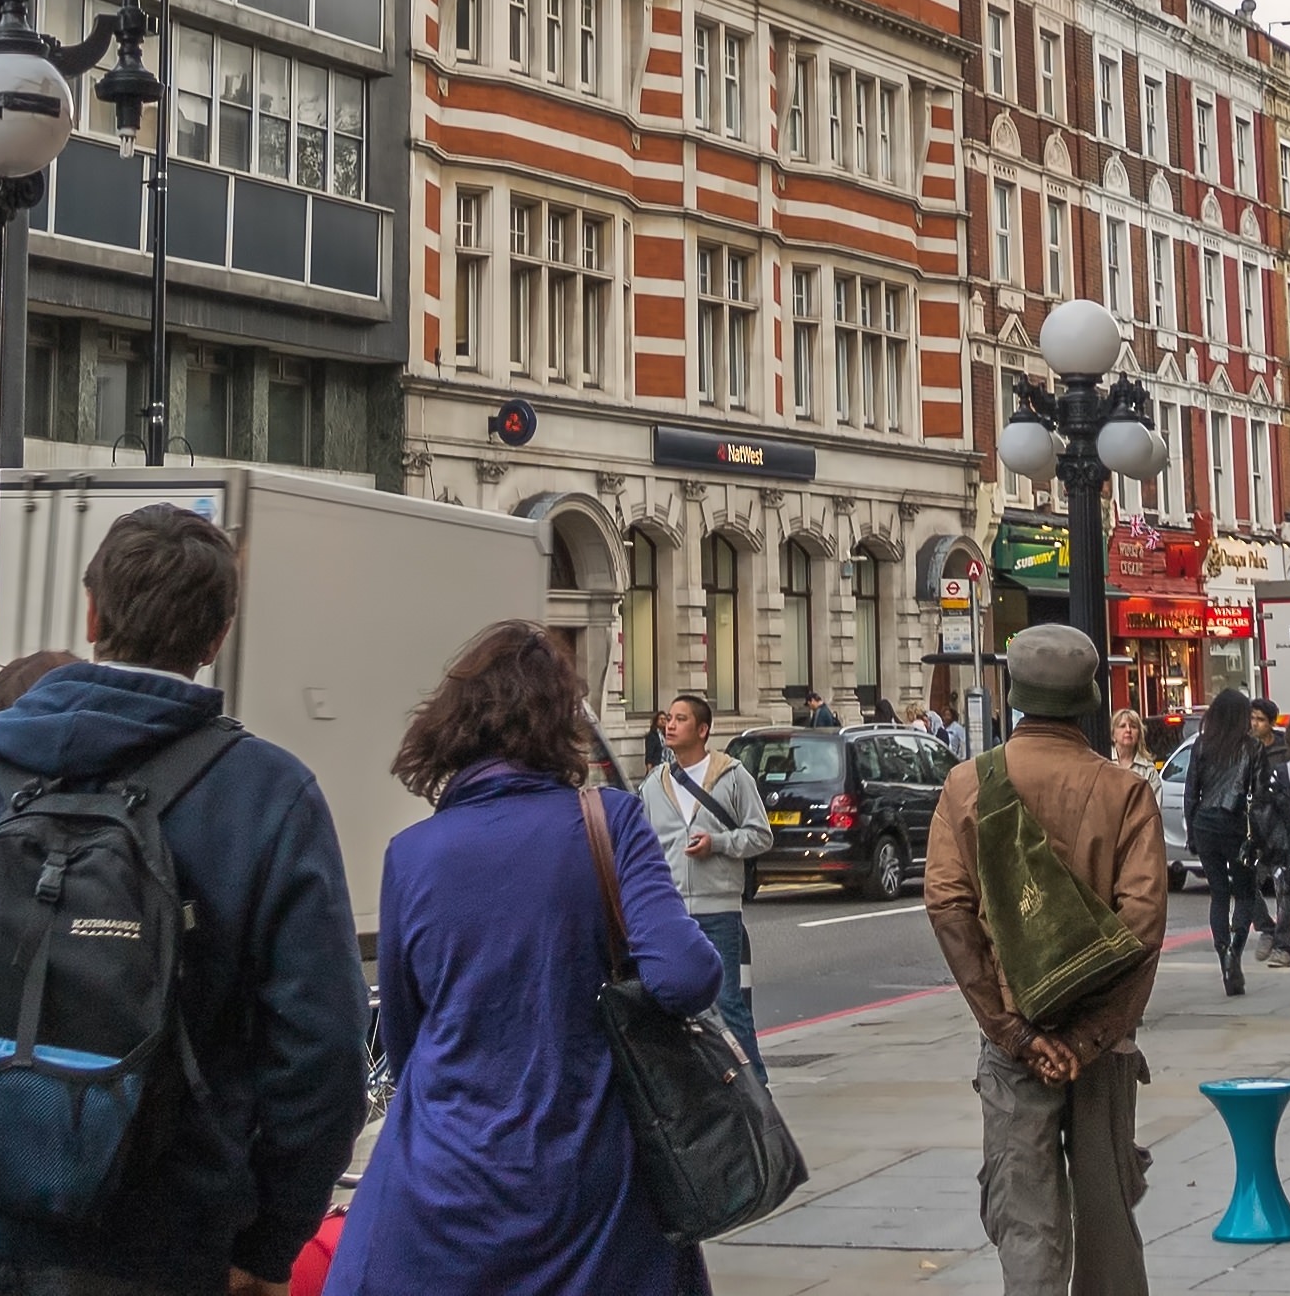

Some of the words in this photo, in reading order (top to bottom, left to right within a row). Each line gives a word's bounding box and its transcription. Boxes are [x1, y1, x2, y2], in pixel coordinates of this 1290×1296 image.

[727, 443, 764, 466] NatWest
[1014, 550, 1056, 571] SUBWAY
[969, 562, 980, 577] A
[1214, 607, 1242, 616] WINES
[1216, 618, 1250, 627] CIGARS
